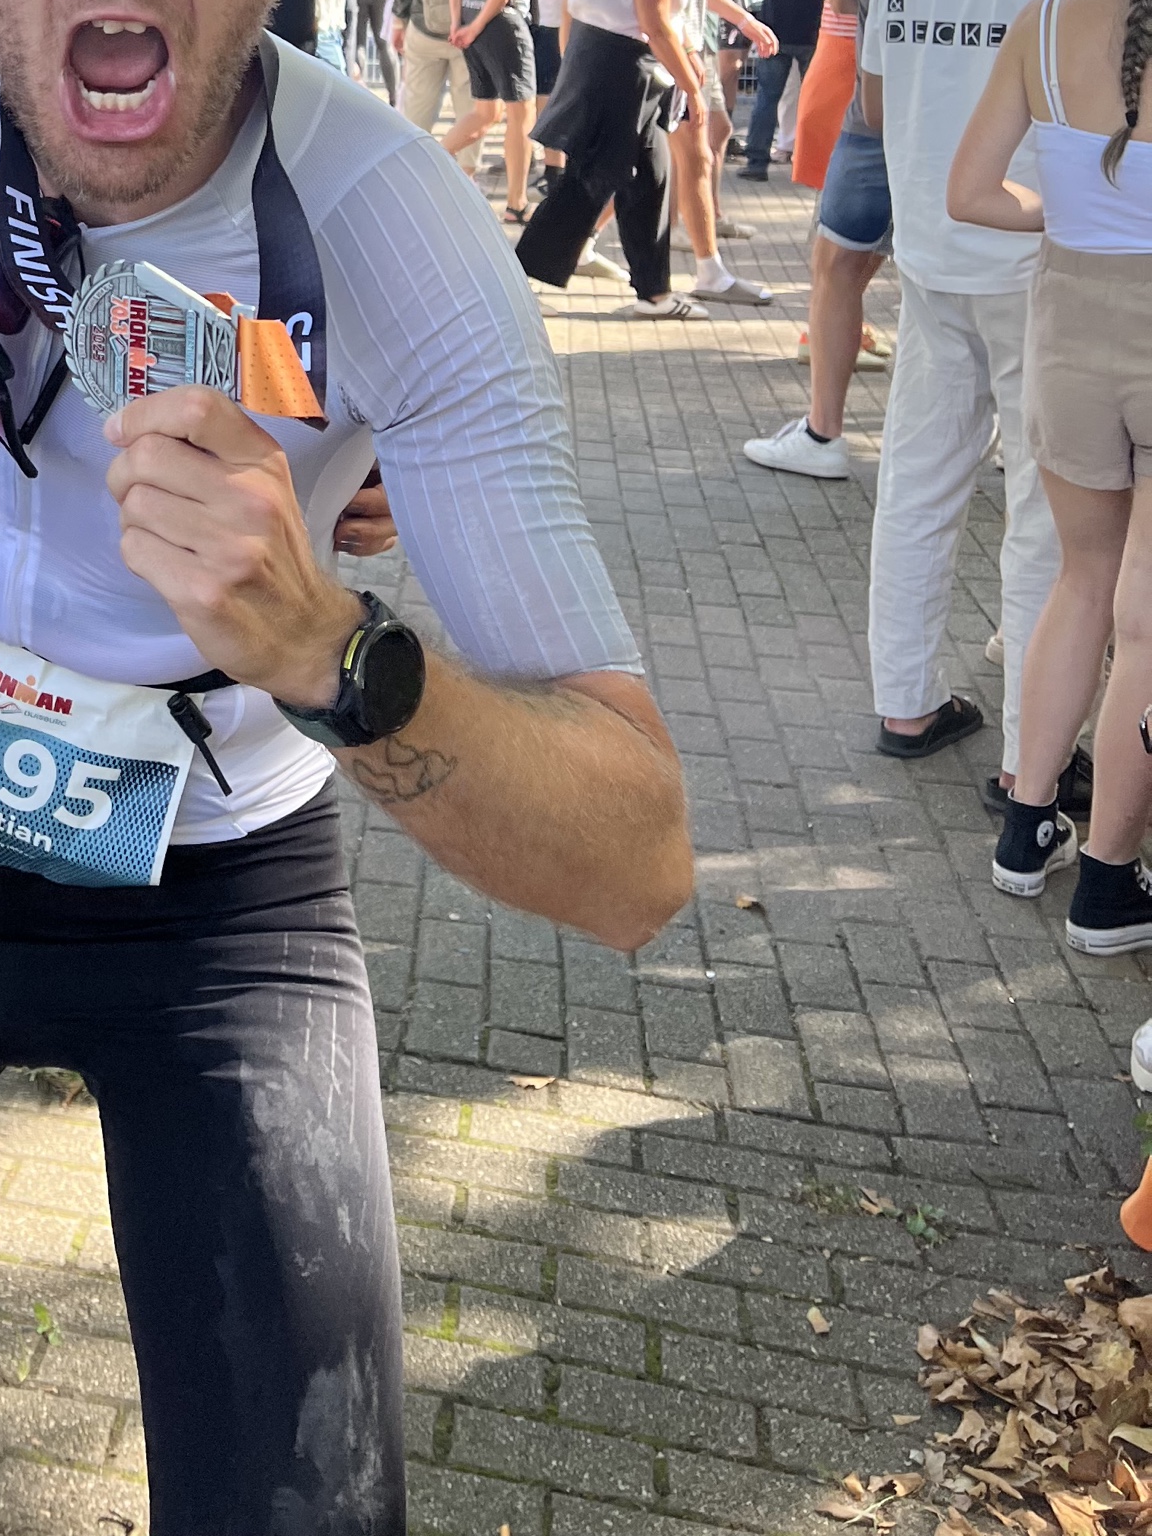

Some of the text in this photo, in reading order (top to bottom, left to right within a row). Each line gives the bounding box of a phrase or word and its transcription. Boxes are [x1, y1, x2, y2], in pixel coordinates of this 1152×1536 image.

[110, 295, 129, 335] 70.3
[92, 324, 106, 363] 2025
[129, 299, 156, 396] IRONMAN
